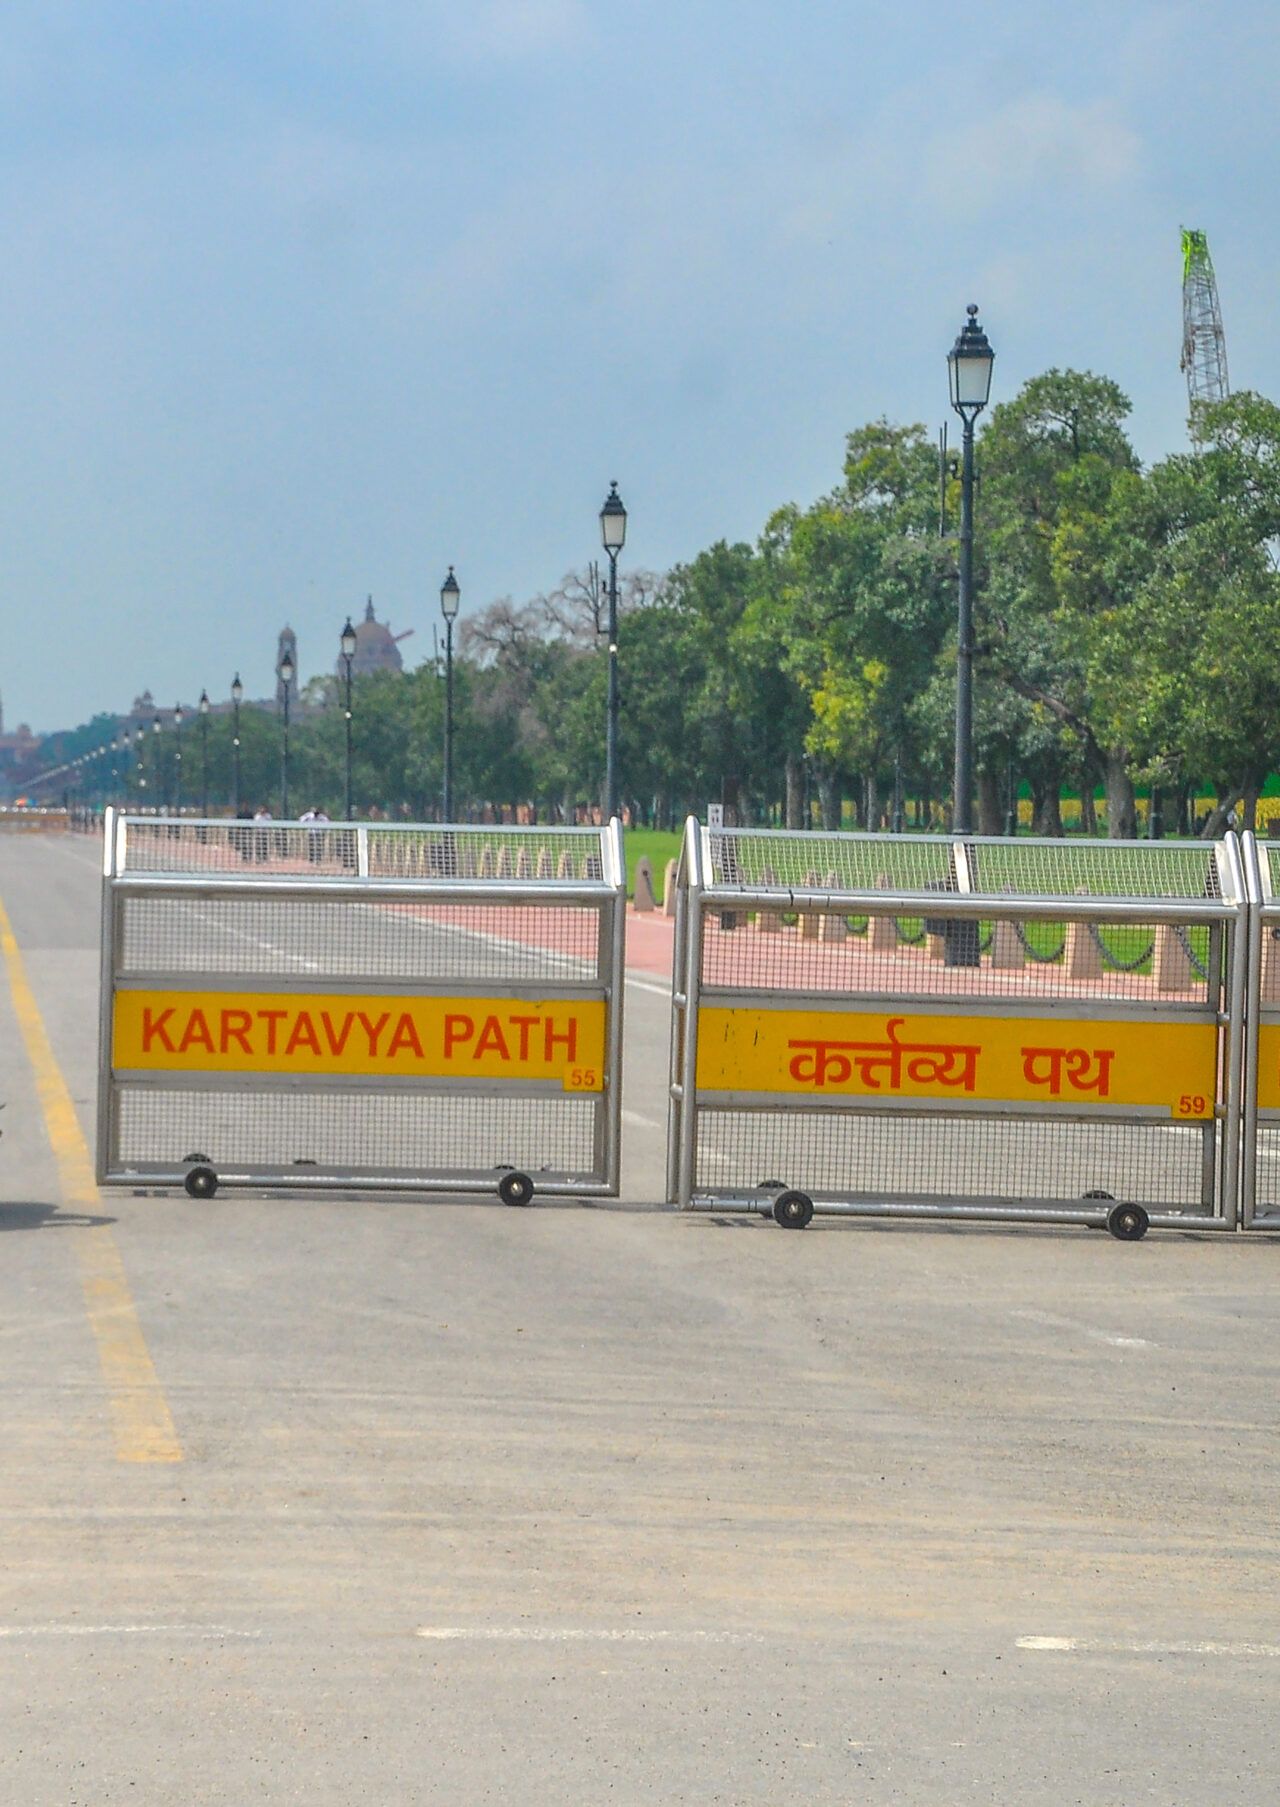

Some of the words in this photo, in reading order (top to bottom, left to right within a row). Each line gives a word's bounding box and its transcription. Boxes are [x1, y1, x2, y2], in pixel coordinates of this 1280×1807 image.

[141, 1008, 424, 1057] KARTAVYA
[443, 1014, 577, 1062] PATH
[788, 1018, 981, 1091] कर्त्तव्य
[1021, 1047, 1115, 1096] पथ
[571, 1069, 596, 1087] 55
[1179, 1095, 1206, 1114] 59
